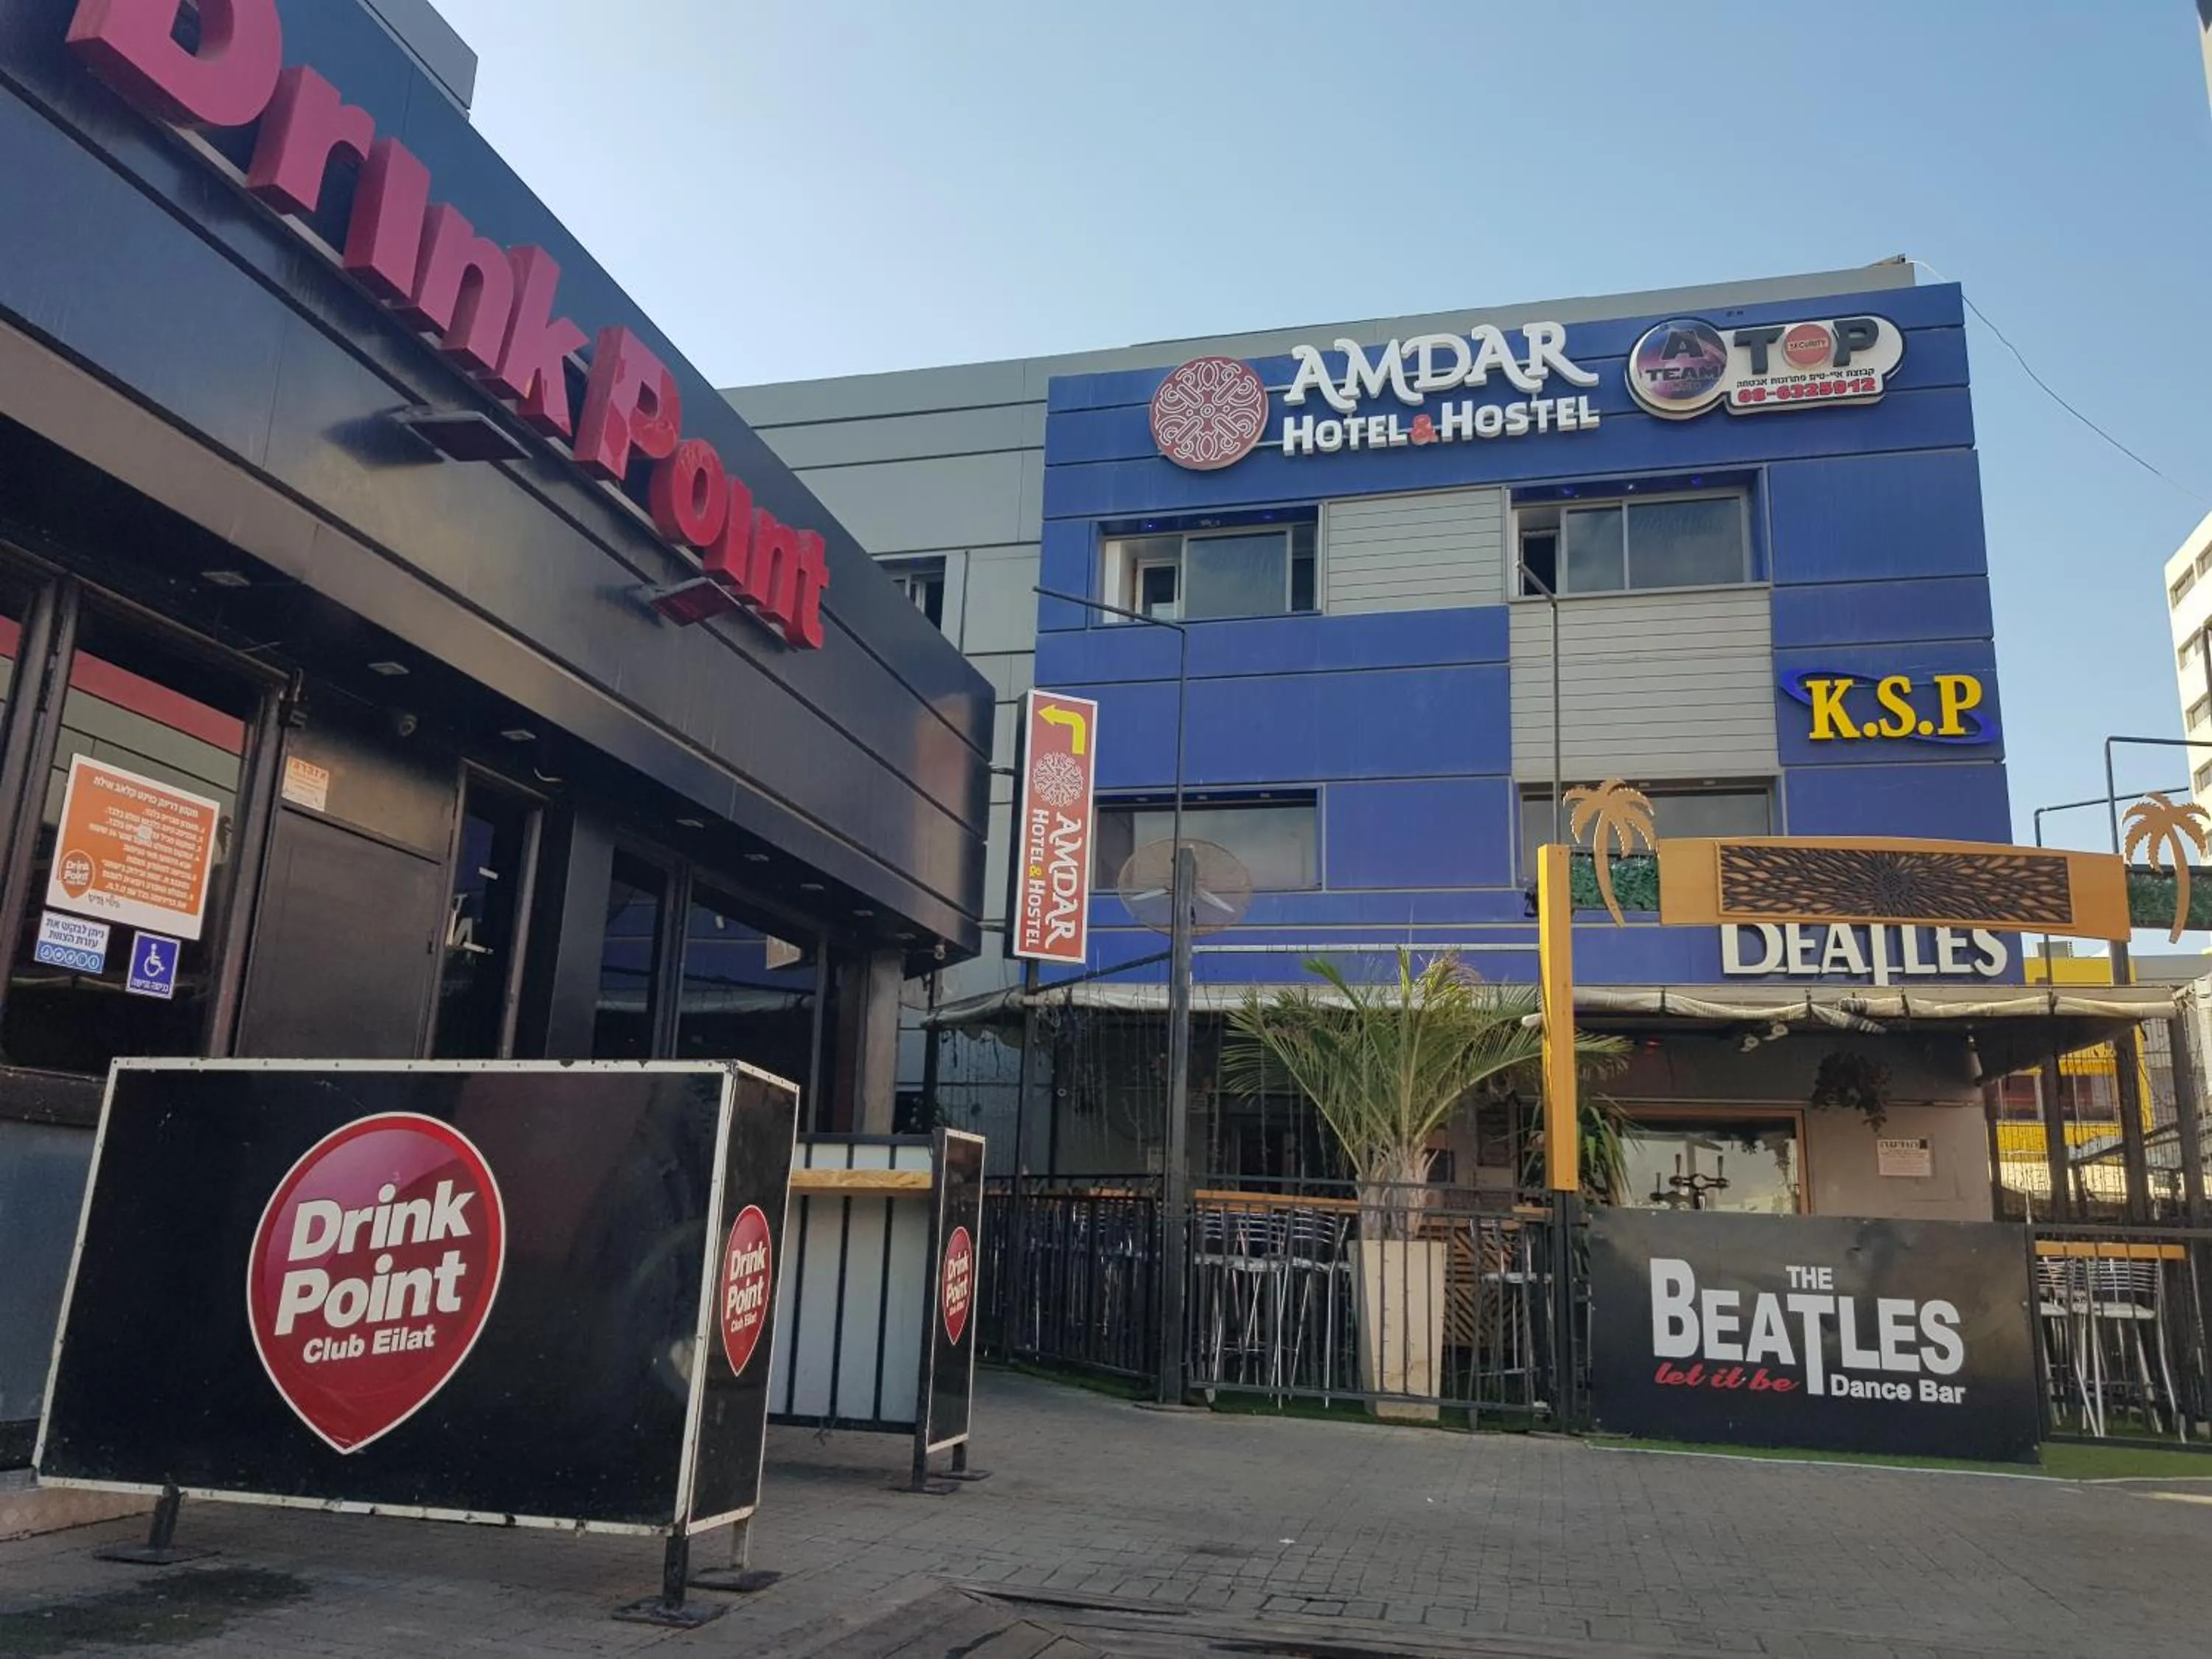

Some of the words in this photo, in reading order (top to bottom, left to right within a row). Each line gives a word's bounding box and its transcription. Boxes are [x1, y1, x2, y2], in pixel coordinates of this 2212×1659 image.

[1284, 321, 1599, 413] AMDAR
[1645, 364, 1719, 381] TEAM
[1441, 396, 1600, 442] HOSTEL
[574, 325, 830, 650] Point
[1806, 675, 1983, 740] K.S.P
[1030, 809, 1049, 865] HOTEL
[1046, 811, 1082, 949] AMDAR
[1026, 878, 1046, 947] HOSTEL
[288, 1180, 476, 1262] Drink
[729, 1241, 767, 1281] Drink
[1786, 1265, 1834, 1290] THE
[274, 1251, 467, 1335] Point
[726, 1276, 765, 1320] Point
[302, 1332, 365, 1363] Club
[372, 1324, 436, 1354] Eilat
[1650, 1258, 1964, 1395] BEATLES
[1655, 1362, 1708, 1385] let
[1710, 1366, 1747, 1389] it
[1749, 1368, 1799, 1391] be
[1830, 1374, 1912, 1400] Dance
[1919, 1379, 1966, 1404] Bar
